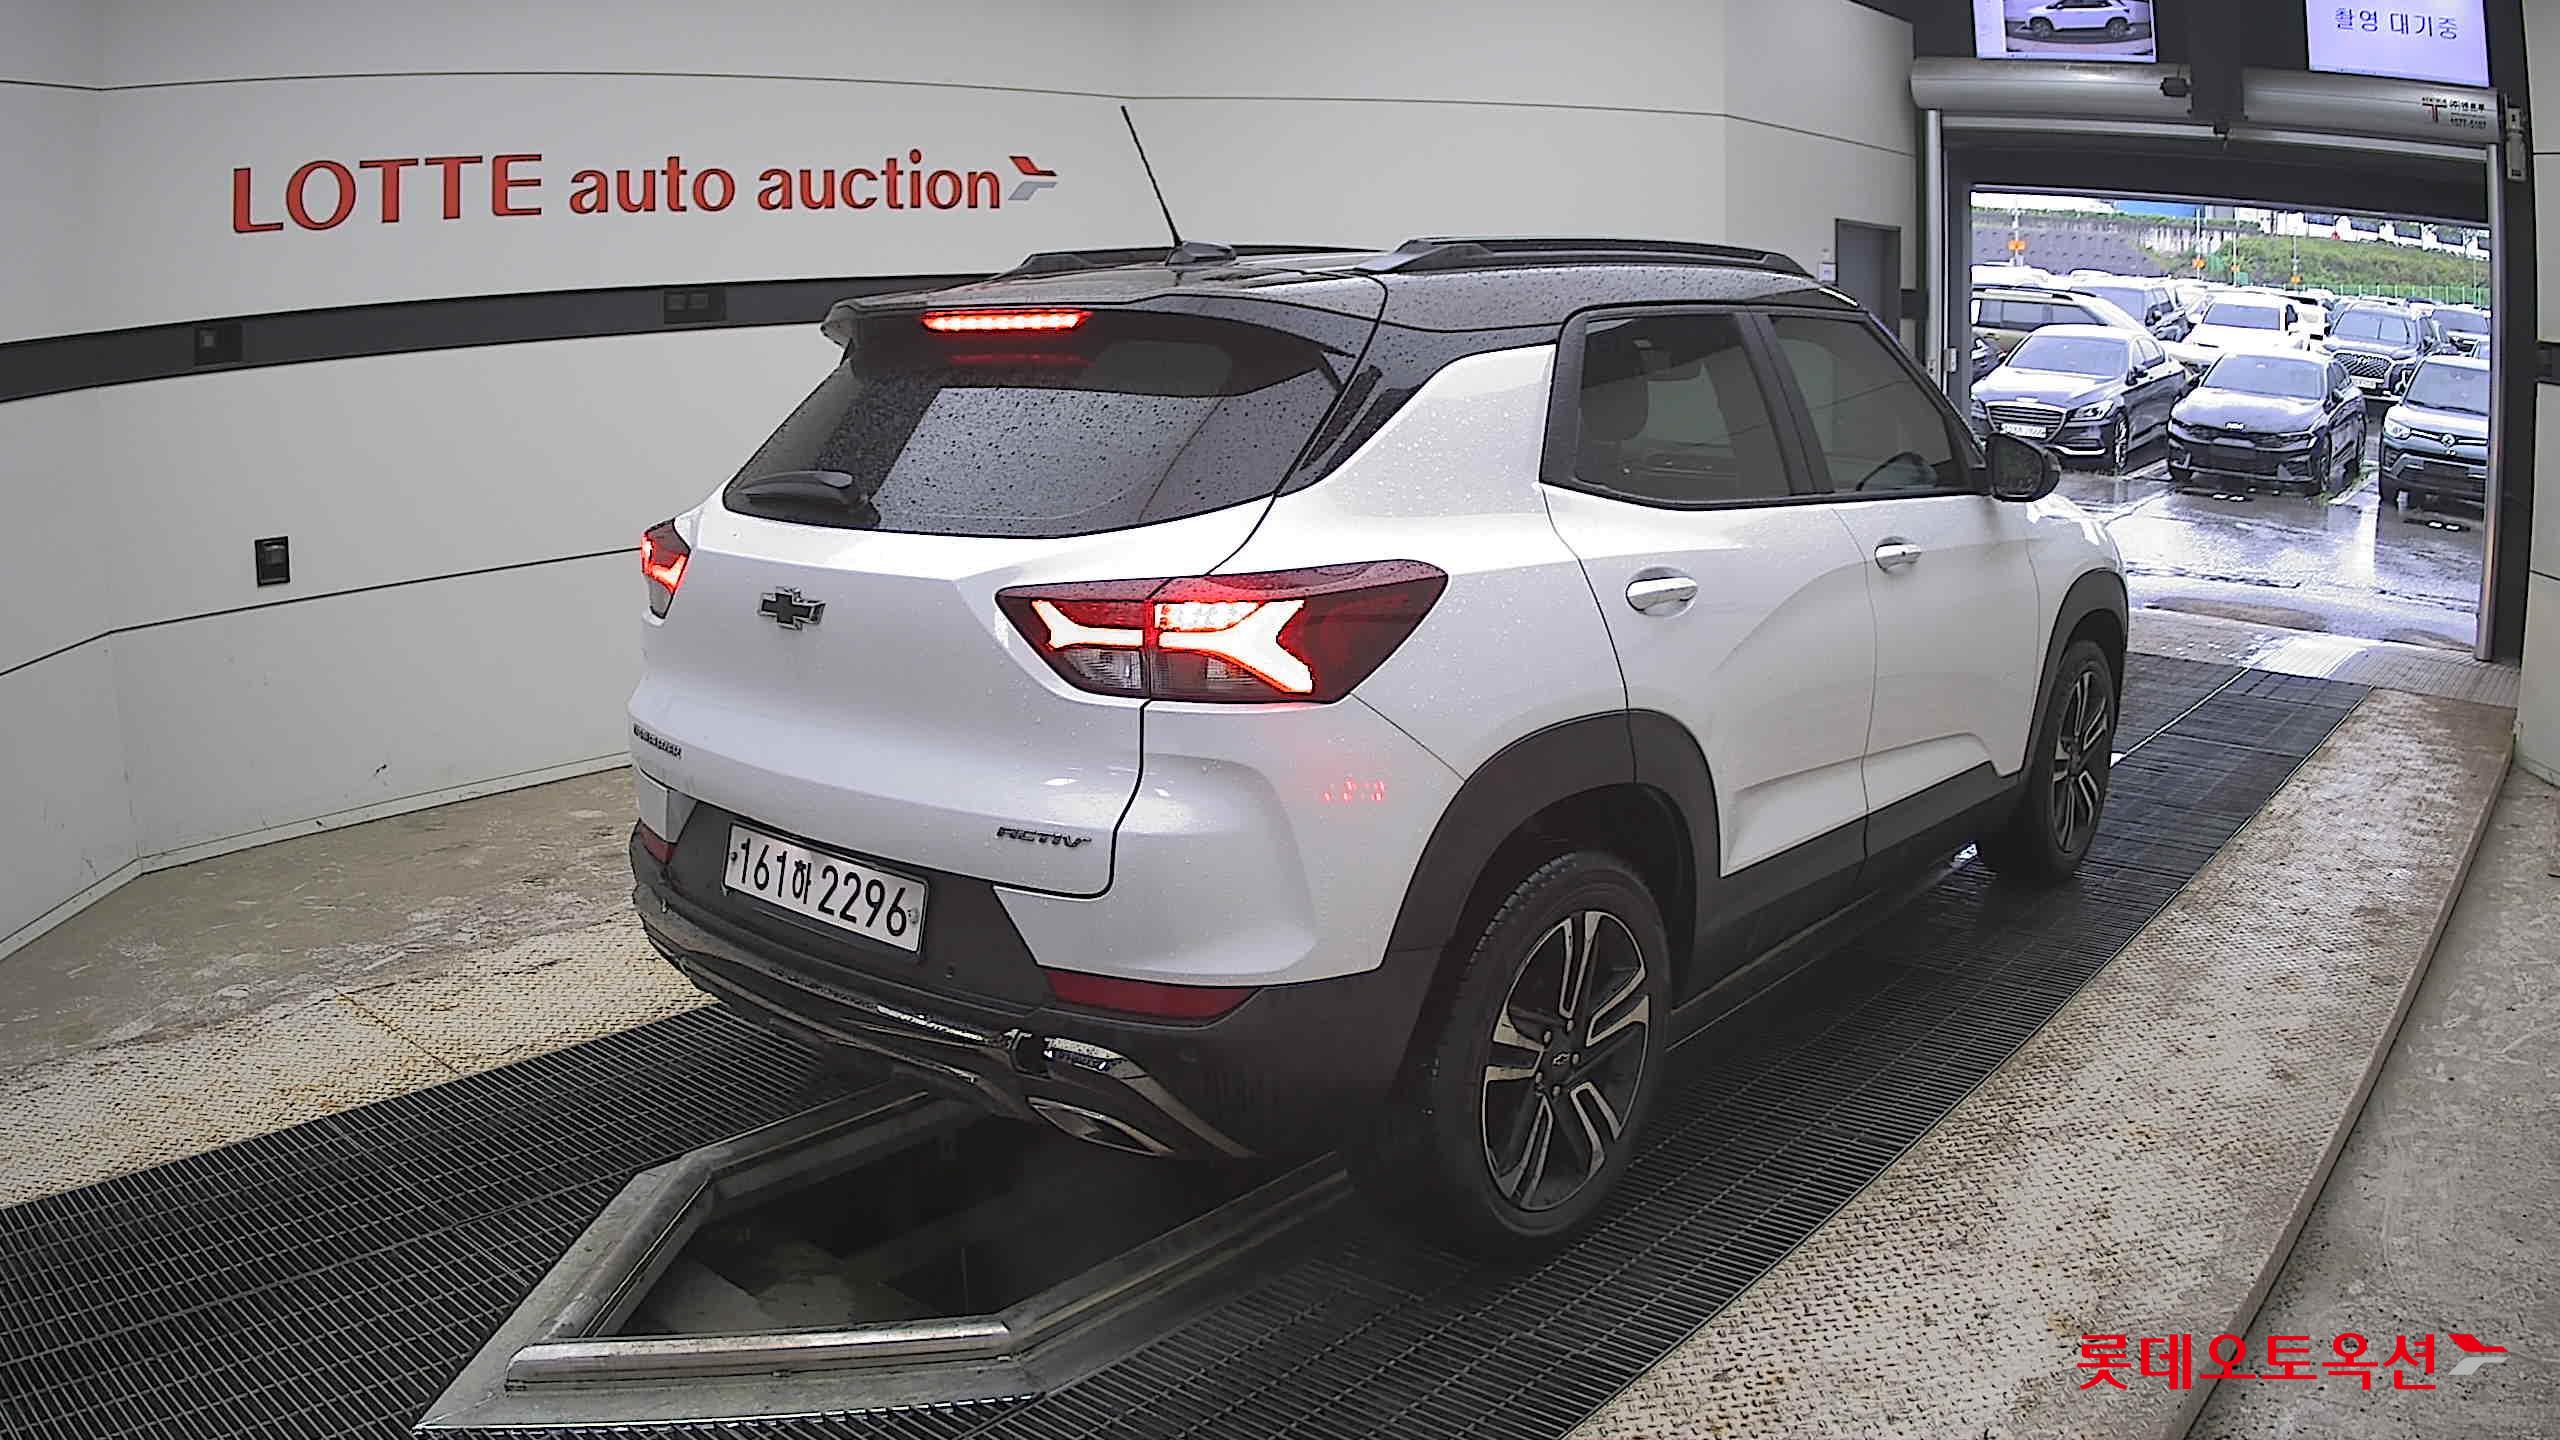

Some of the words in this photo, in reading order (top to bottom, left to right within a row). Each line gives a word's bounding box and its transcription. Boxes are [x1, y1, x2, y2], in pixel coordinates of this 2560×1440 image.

[2335, 7, 2378, 33] 촬영
[2390, 12, 2458, 40] 대기중
[232, 153, 543, 235] LOTTE
[568, 155, 737, 215] auto
[756, 148, 1002, 213] auction
[817, 864, 908, 938] 2296
